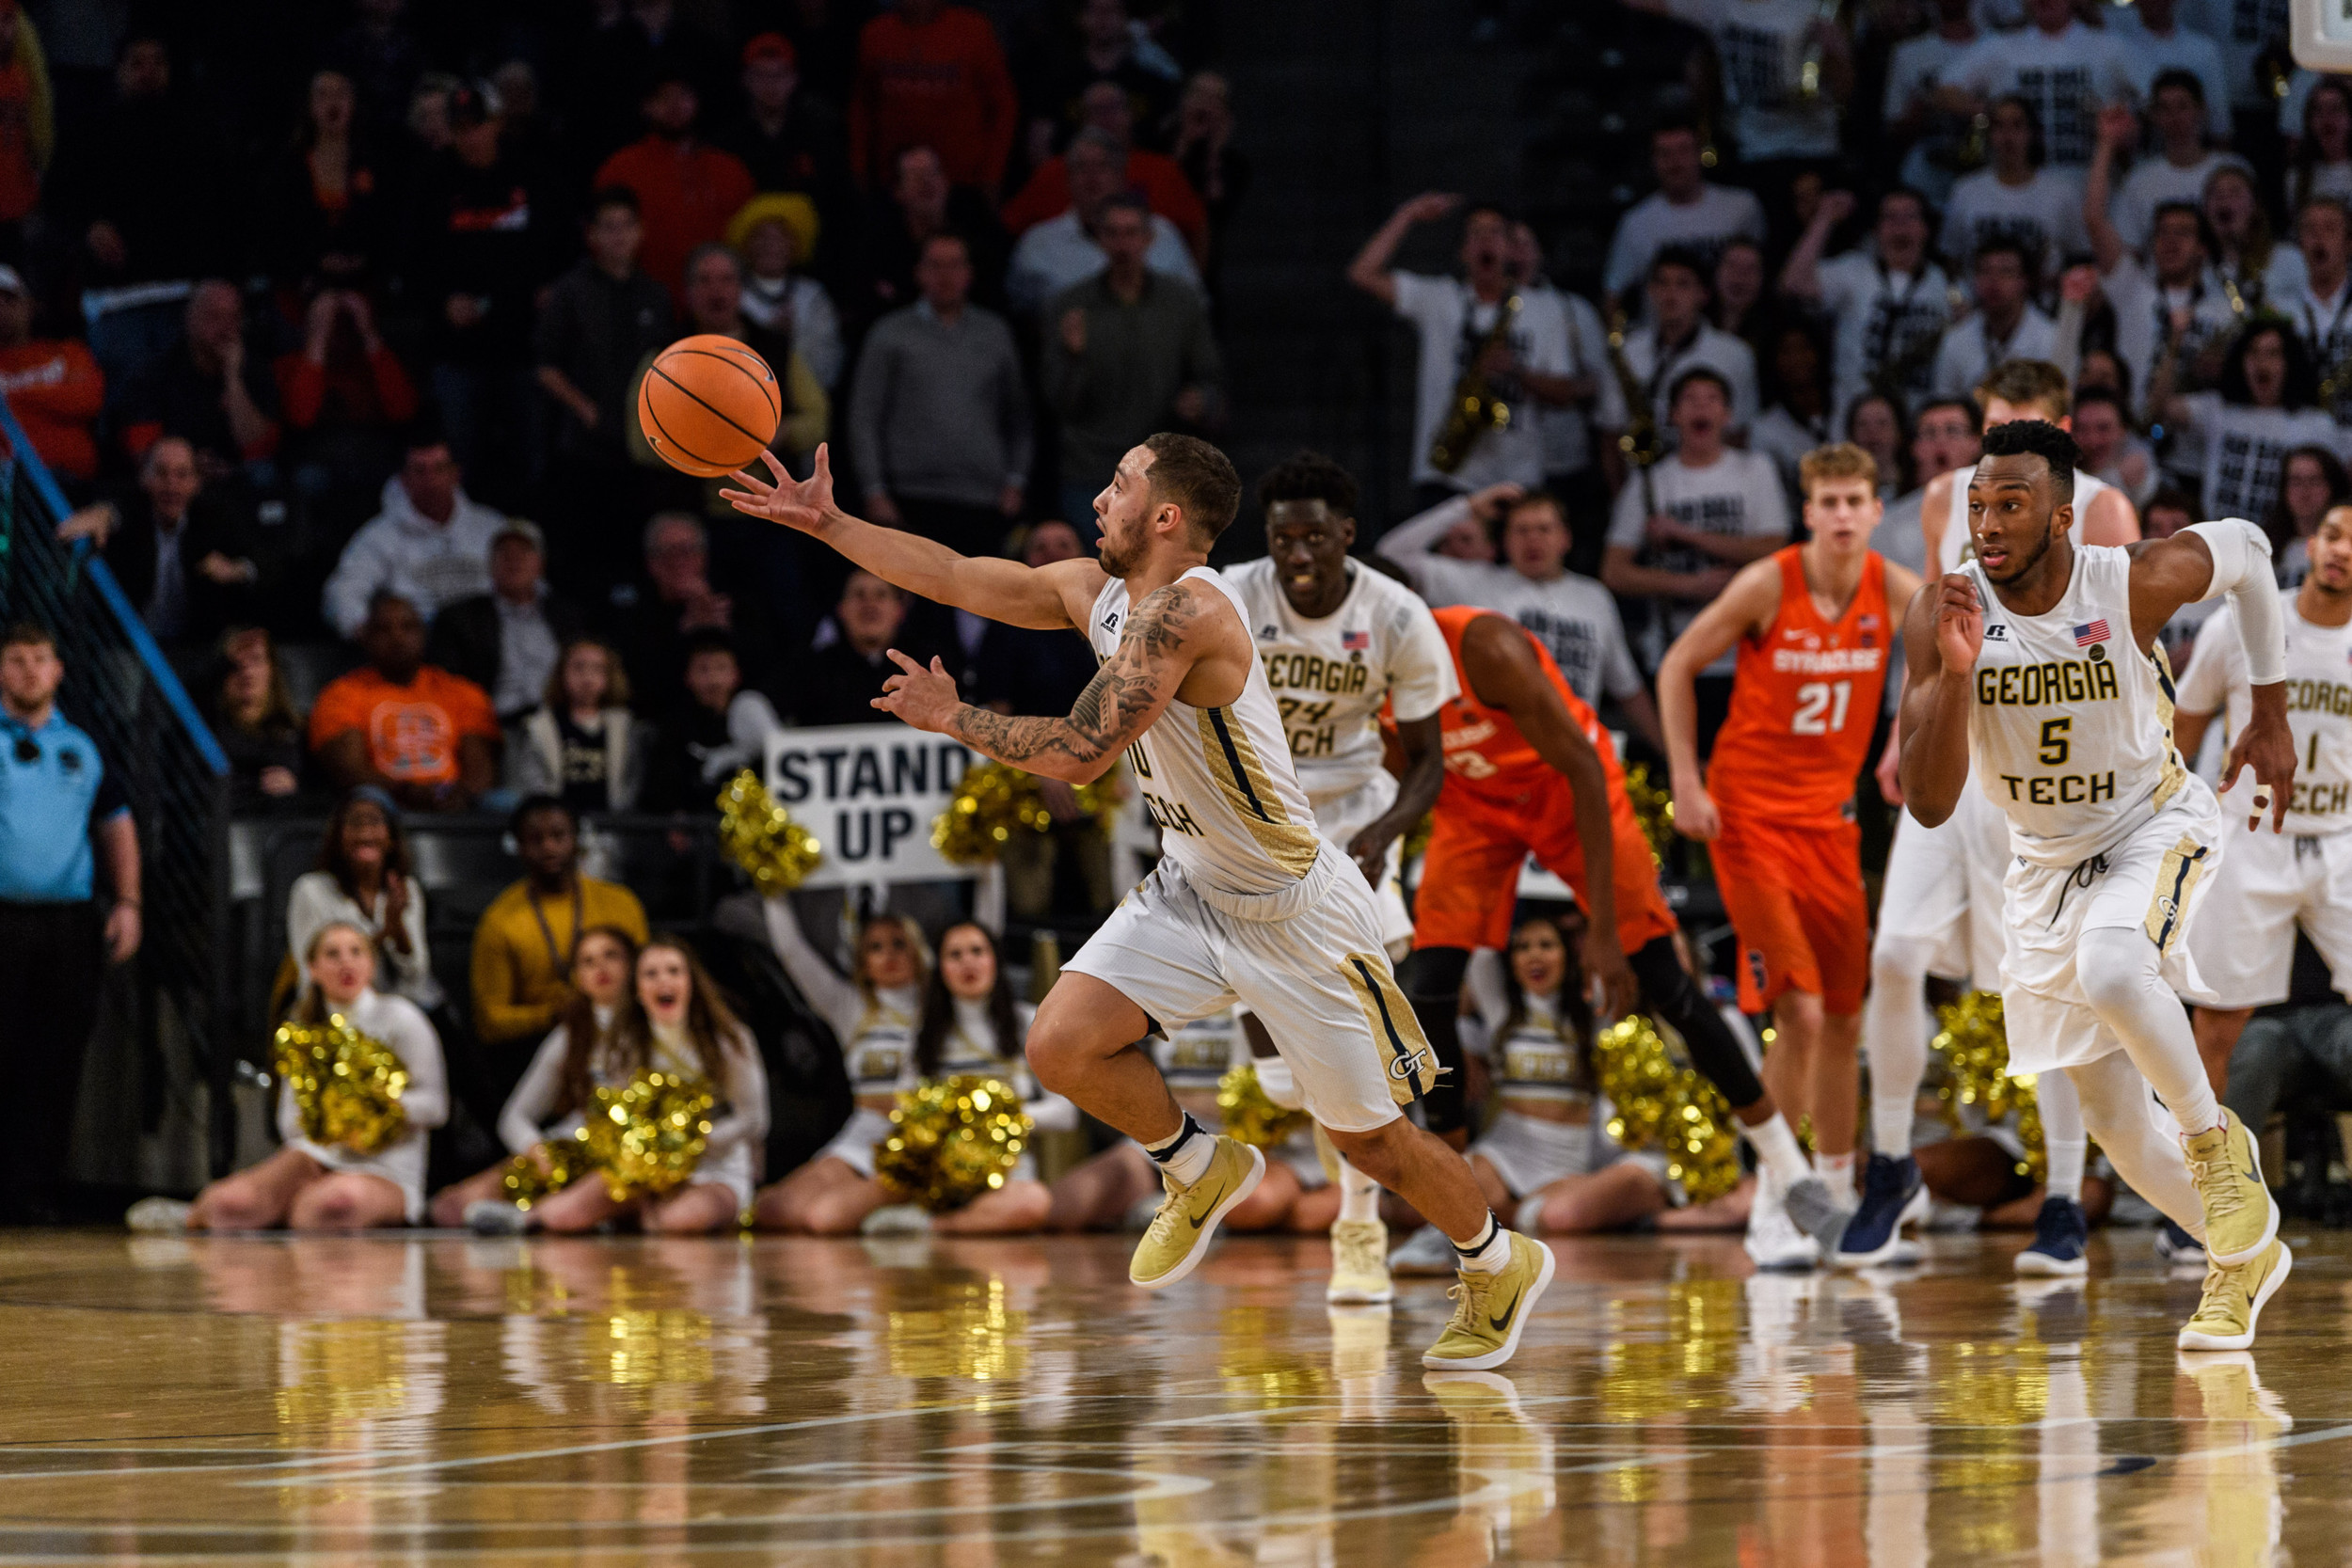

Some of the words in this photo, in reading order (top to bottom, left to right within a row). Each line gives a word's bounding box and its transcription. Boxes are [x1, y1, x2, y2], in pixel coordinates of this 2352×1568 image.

[1261, 653, 1368, 694] EORGIA
[1979, 660, 2119, 705] GEORGIA
[1790, 678, 1852, 736] 21
[1285, 722, 1336, 756] CH
[2038, 716, 2073, 768] 5
[2306, 728, 2319, 773] 1
[779, 744, 971, 801] STAND
[1441, 749, 1500, 781] 3
[2000, 770, 2116, 806] TECH
[2289, 778, 2350, 815] ECH
[839, 809, 914, 861] UP
[1141, 791, 1206, 837] ECH
[1389, 1048, 1428, 1081] GT
